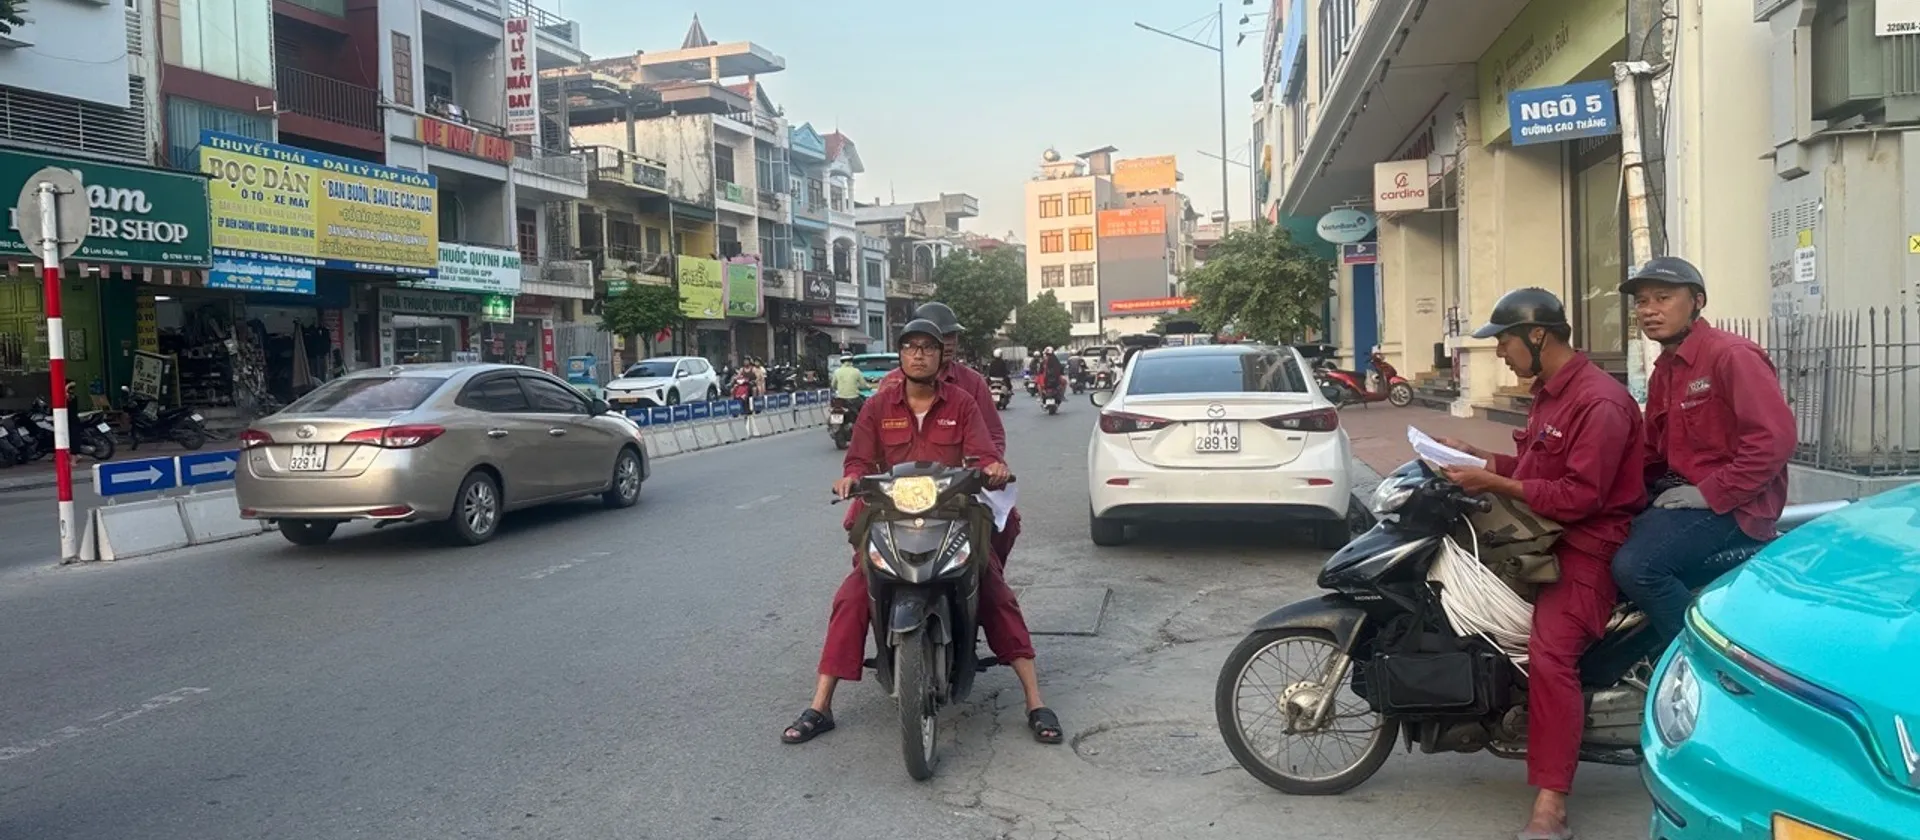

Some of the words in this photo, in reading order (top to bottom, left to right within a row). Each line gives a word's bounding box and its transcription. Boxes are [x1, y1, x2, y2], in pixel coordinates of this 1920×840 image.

[507, 19, 527, 35] ĐẠI
[511, 36, 524, 52] LÝ
[507, 72, 532, 90] MÁY
[508, 93, 531, 108] BAY
[1520, 94, 1577, 120] NGÕ
[1585, 94, 1602, 113] 5
[1521, 123, 1553, 136] ĐƯỜNG
[1555, 121, 1573, 132] CAO
[1575, 115, 1607, 129] THẮNG
[210, 136, 269, 156] THUYẾT
[272, 149, 305, 164] THÁI
[352, 165, 370, 176] LÝ
[401, 174, 430, 187] HÓA
[208, 157, 256, 189] BỌC
[262, 165, 311, 194] DÁN
[273, 194, 286, 206] XE
[1380, 188, 1425, 200] cardina
[121, 219, 189, 244] SHOP
[501, 254, 520, 269] ANH
[1206, 421, 1228, 435] 14A
[1196, 437, 1238, 450] 289.19
